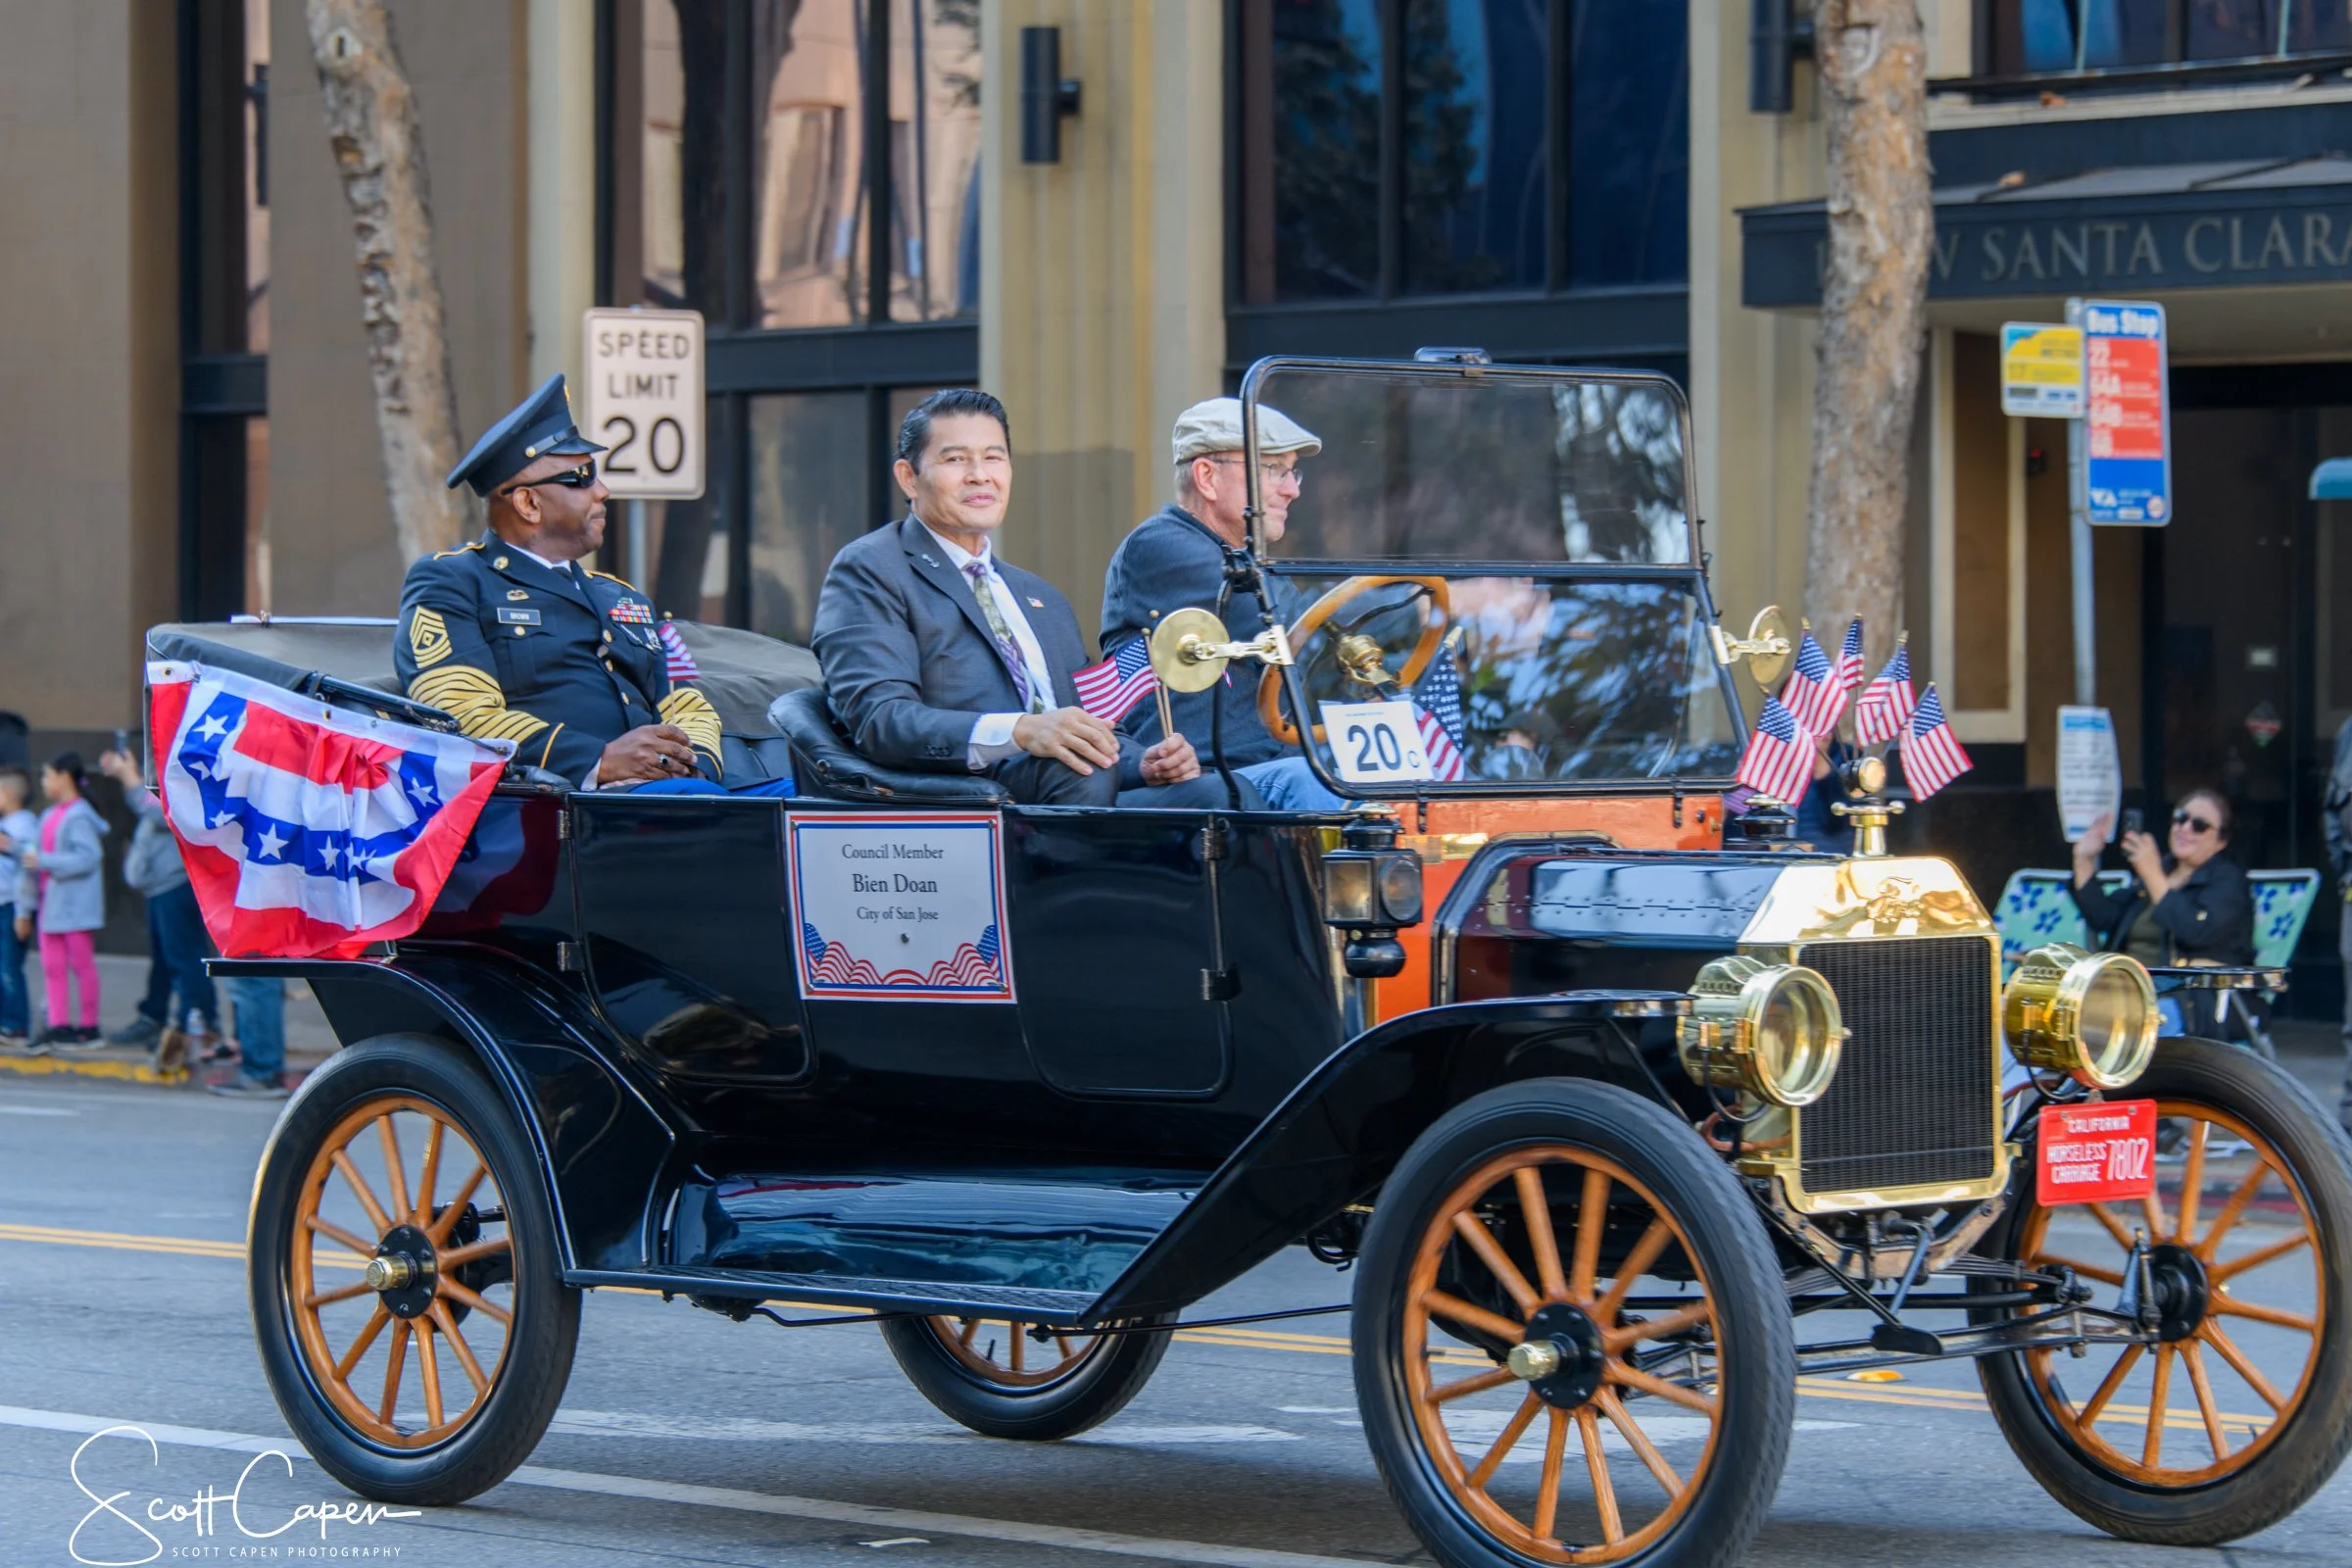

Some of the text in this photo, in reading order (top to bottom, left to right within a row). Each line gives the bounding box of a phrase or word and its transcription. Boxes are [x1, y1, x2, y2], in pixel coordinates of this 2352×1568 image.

[1981, 221, 2163, 281] SANTA
[599, 330, 689, 360] SPEED
[608, 373, 678, 400] LIMIT
[602, 416, 685, 474] 20
[1348, 723, 1401, 772] 20
[842, 844, 944, 858] Council Member
[852, 873, 938, 893] Bien Doan
[857, 906, 939, 923] City of San Jose
[2068, 1115, 2131, 1133] CALIFORNIA
[2046, 1142, 2107, 1164] HORSELESS
[2050, 1163, 2102, 1185] CARRIAGE
